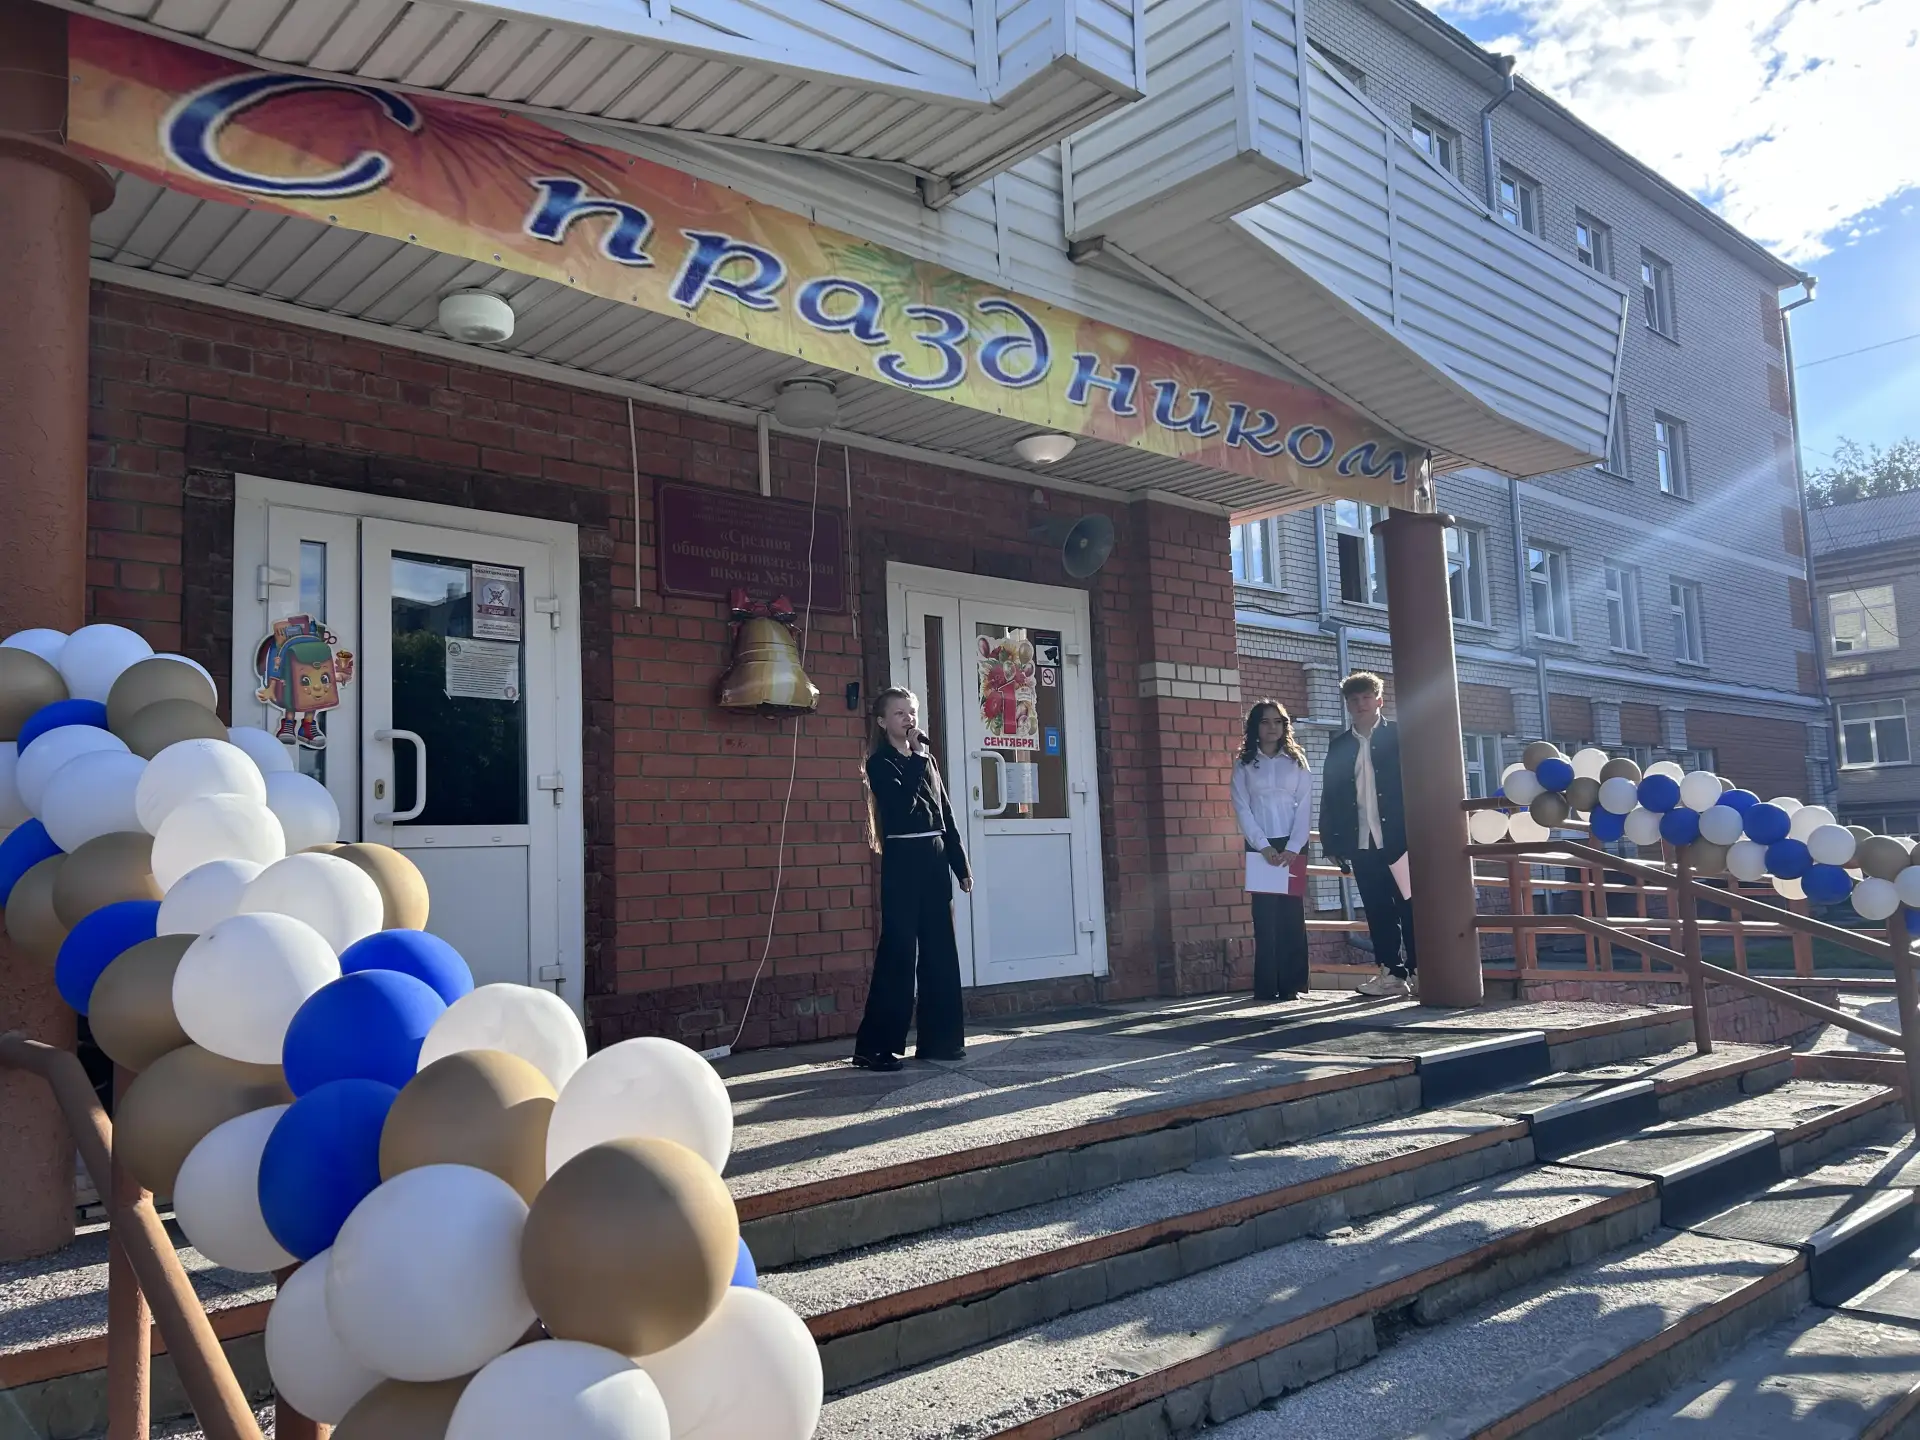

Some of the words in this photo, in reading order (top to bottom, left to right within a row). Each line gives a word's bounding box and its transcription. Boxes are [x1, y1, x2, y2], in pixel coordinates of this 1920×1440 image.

[159, 71, 422, 197] С
[524, 176, 1410, 483] праздником
[710, 566, 760, 585] школа
[983, 736, 1034, 748] СЕНТЯБРЯ
